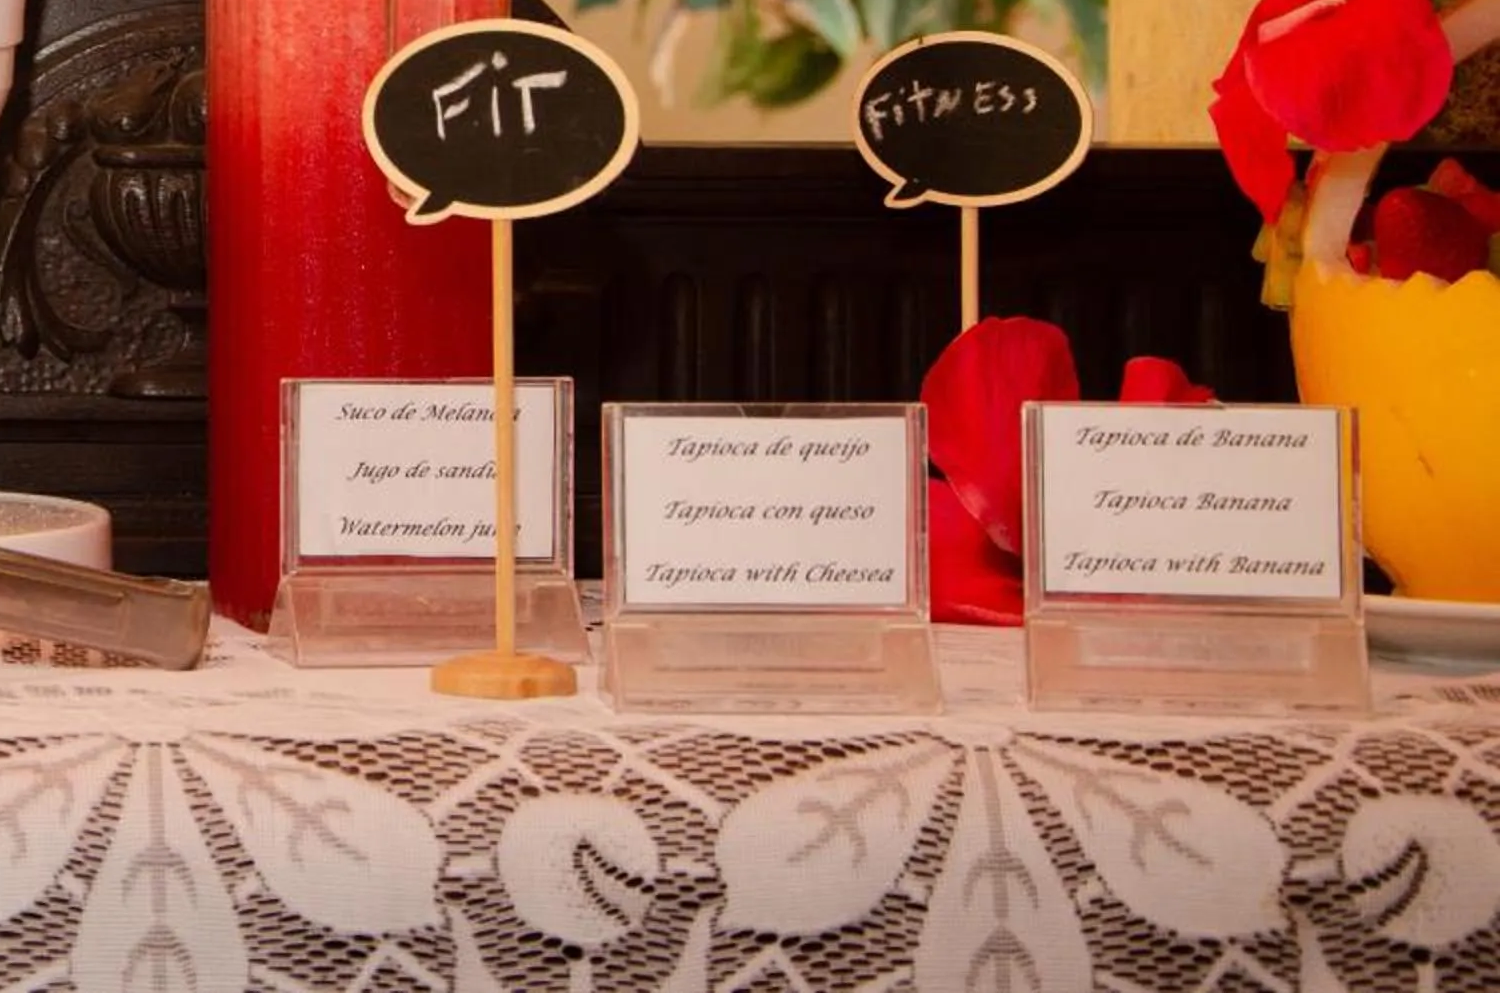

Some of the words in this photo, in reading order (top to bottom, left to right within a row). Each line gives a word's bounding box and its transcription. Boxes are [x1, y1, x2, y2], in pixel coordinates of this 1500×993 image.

[335, 402, 386, 422] Suco
[390, 401, 417, 421] de
[668, 437, 759, 464] Tapioca
[764, 435, 794, 457] de
[799, 439, 870, 464] queijo
[1075, 426, 1168, 453] Tapioca
[1175, 425, 1205, 447] de
[1211, 428, 1310, 449] Banana
[346, 460, 400, 484] Jugo
[404, 459, 431, 479] de
[664, 500, 756, 526] Tapioca
[762, 504, 802, 521] con
[809, 504, 876, 526] queso
[1094, 490, 1188, 516] Tapioca
[1196, 492, 1293, 512] Banana
[338, 515, 466, 537] Watermelon
[644, 563, 737, 589] Tapioca
[745, 561, 800, 584] with
[1063, 552, 1157, 578] Tapioca
[1166, 552, 1221, 575] with
[1228, 554, 1327, 577] Banana
